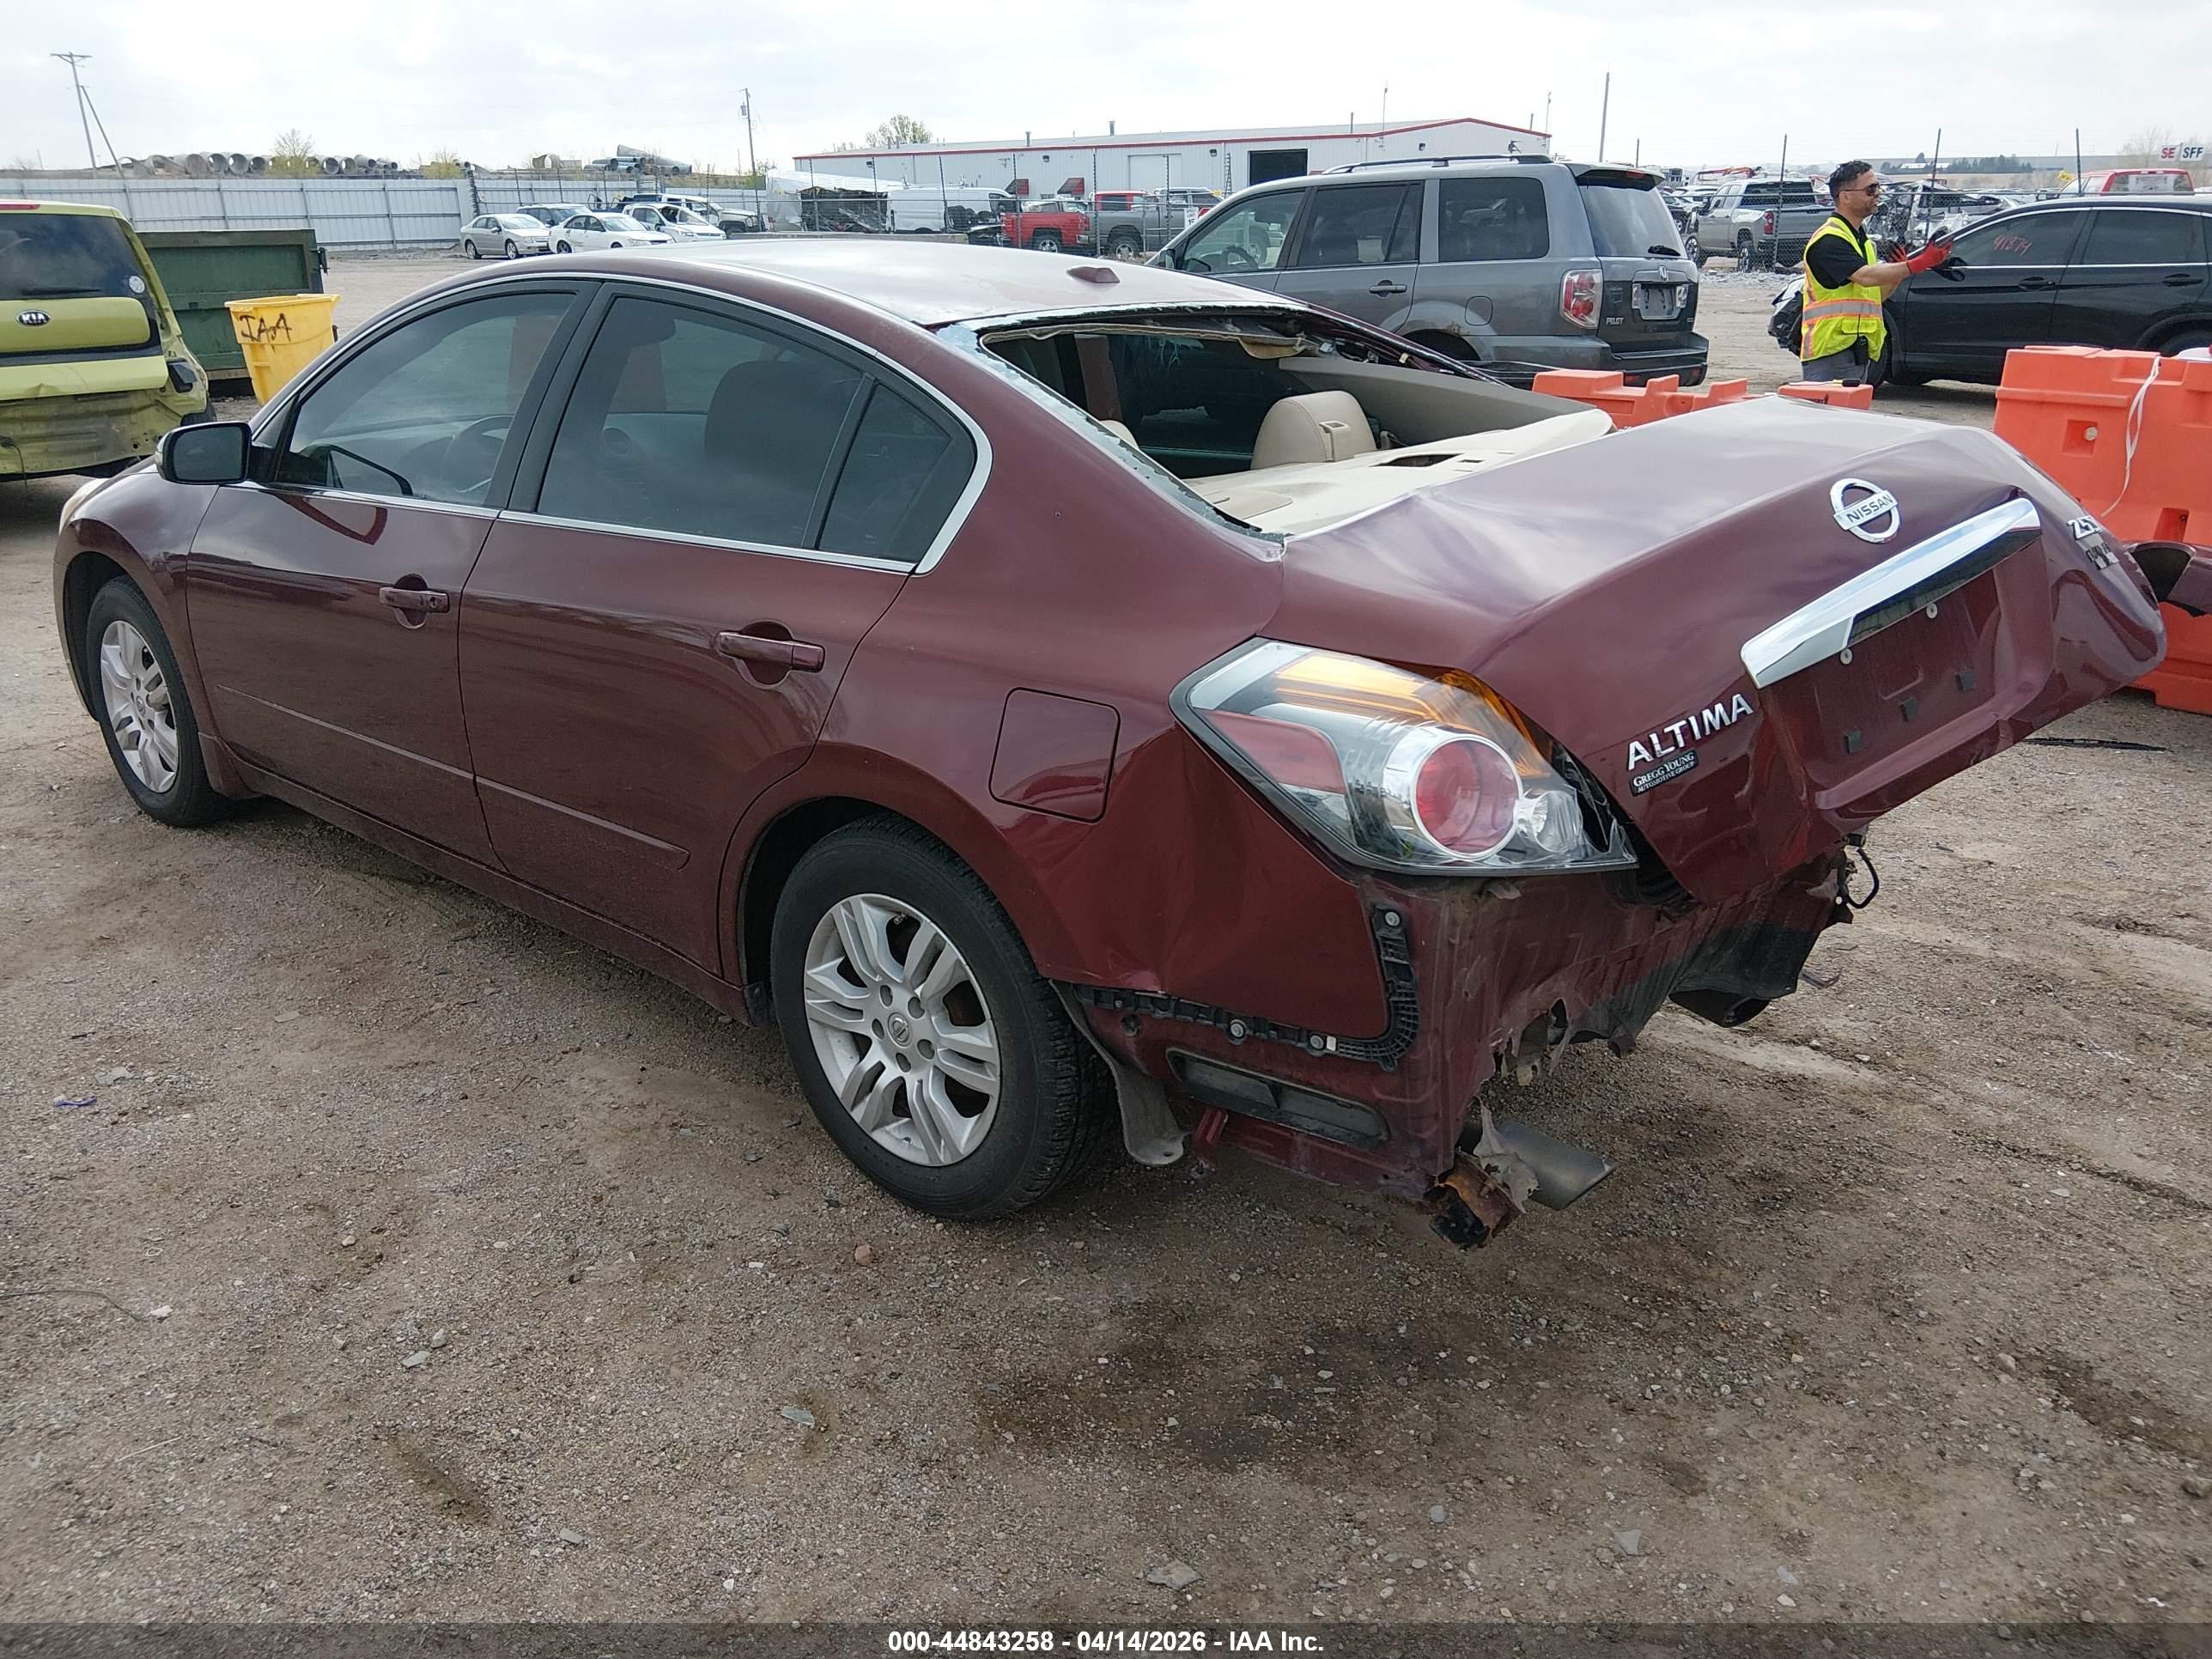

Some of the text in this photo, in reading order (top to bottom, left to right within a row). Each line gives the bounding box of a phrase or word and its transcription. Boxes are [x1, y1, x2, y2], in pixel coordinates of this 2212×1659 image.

[2182, 147, 2203, 159] SFF
[1605, 317, 1625, 325] PILOT
[1845, 494, 1894, 523] NISSAN
[1628, 693, 1754, 770] ALTIMA
[1633, 752, 1695, 787] GREGG YOUNG
[1638, 761, 1696, 793] AUTOMOTIVE GROUP
